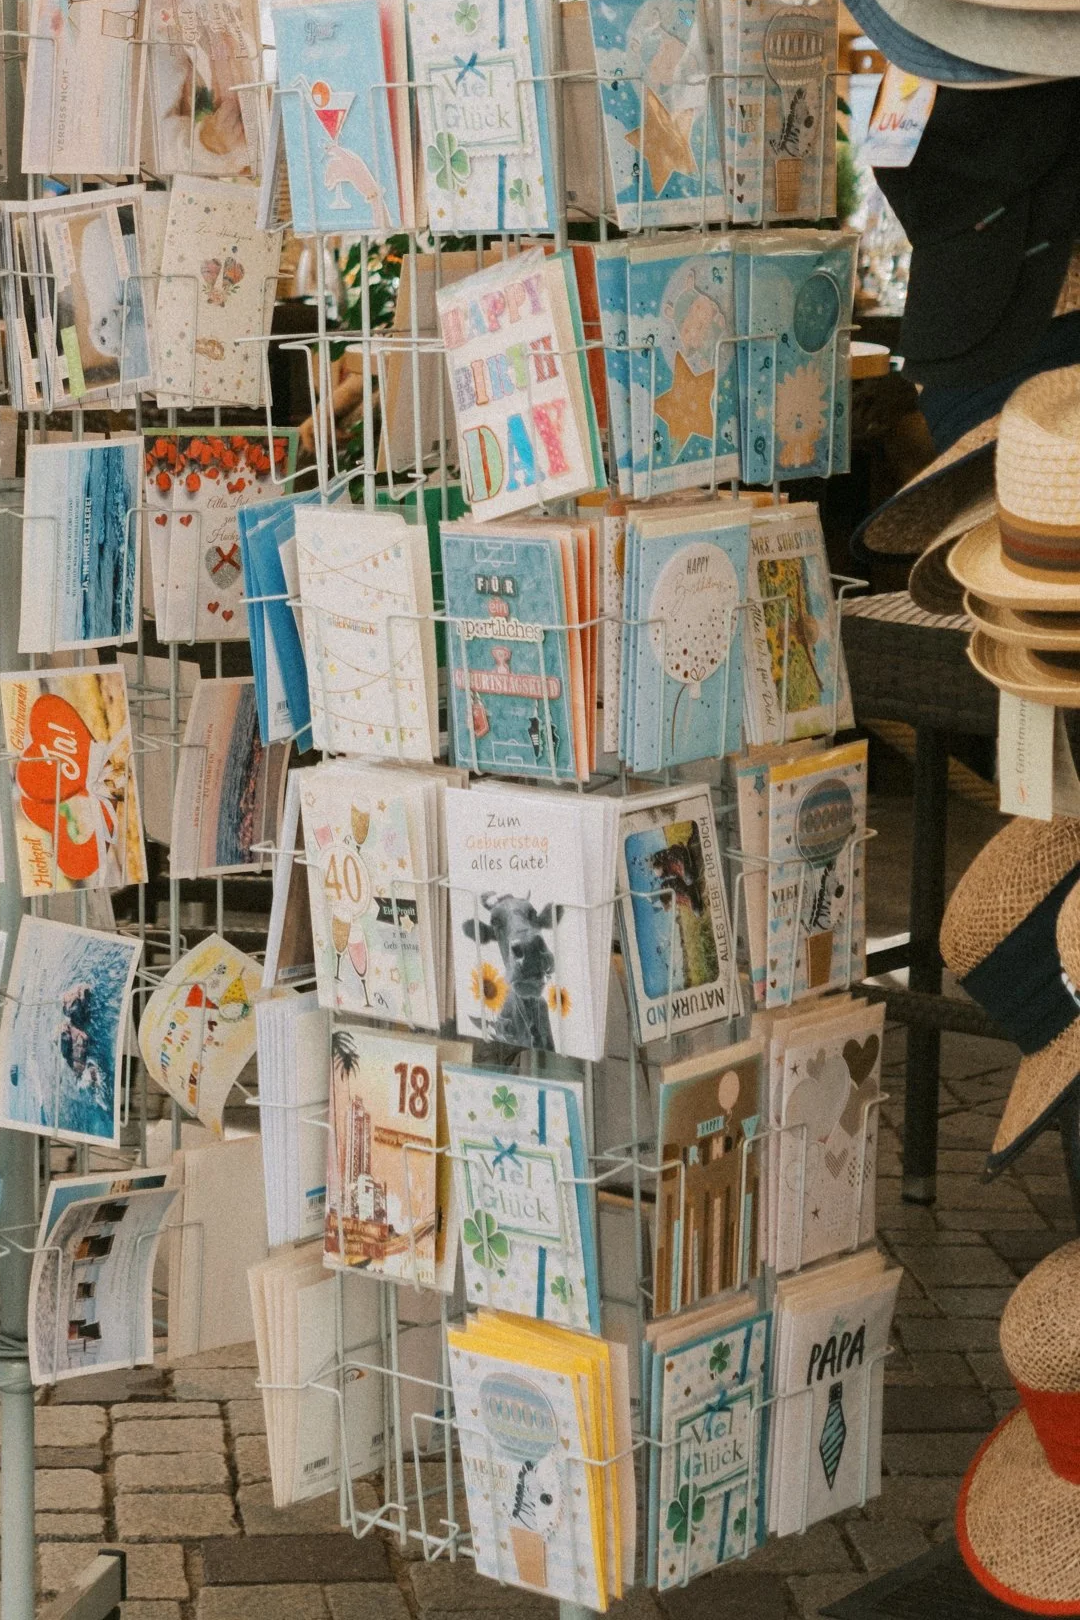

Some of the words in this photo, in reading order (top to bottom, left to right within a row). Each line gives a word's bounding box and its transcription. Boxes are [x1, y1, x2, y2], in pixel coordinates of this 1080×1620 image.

[57, 68, 68, 102] NICHT
[443, 70, 494, 98] Viel
[56, 105, 67, 152] VERGISS
[441, 273, 543, 349] HAPPY
[462, 398, 572, 504] DAY
[83, 496, 92, 530] LEERE!
[83, 531, 92, 562] IHRER
[686, 555, 710, 575] HAPPY
[476, 575, 515, 595] FÜR
[489, 602, 509, 615] ein
[457, 619, 544, 640] portliches
[40, 721, 82, 781] Ja!
[486, 813, 520, 829] Zum
[23, 836, 54, 889] Hochzeit
[466, 833, 549, 853] Geburtstag
[471, 853, 503, 870] alles
[509, 854, 550, 871] Gute!
[324, 853, 362, 904] 40
[716, 923, 729, 963] ALLES
[646, 986, 726, 1027] NATURKND
[393, 1061, 432, 1120] 18
[479, 1152, 533, 1190] Viel
[480, 1181, 552, 1225] Glück
[691, 1406, 734, 1447] Viel
[683, 1438, 746, 1479] Glück
